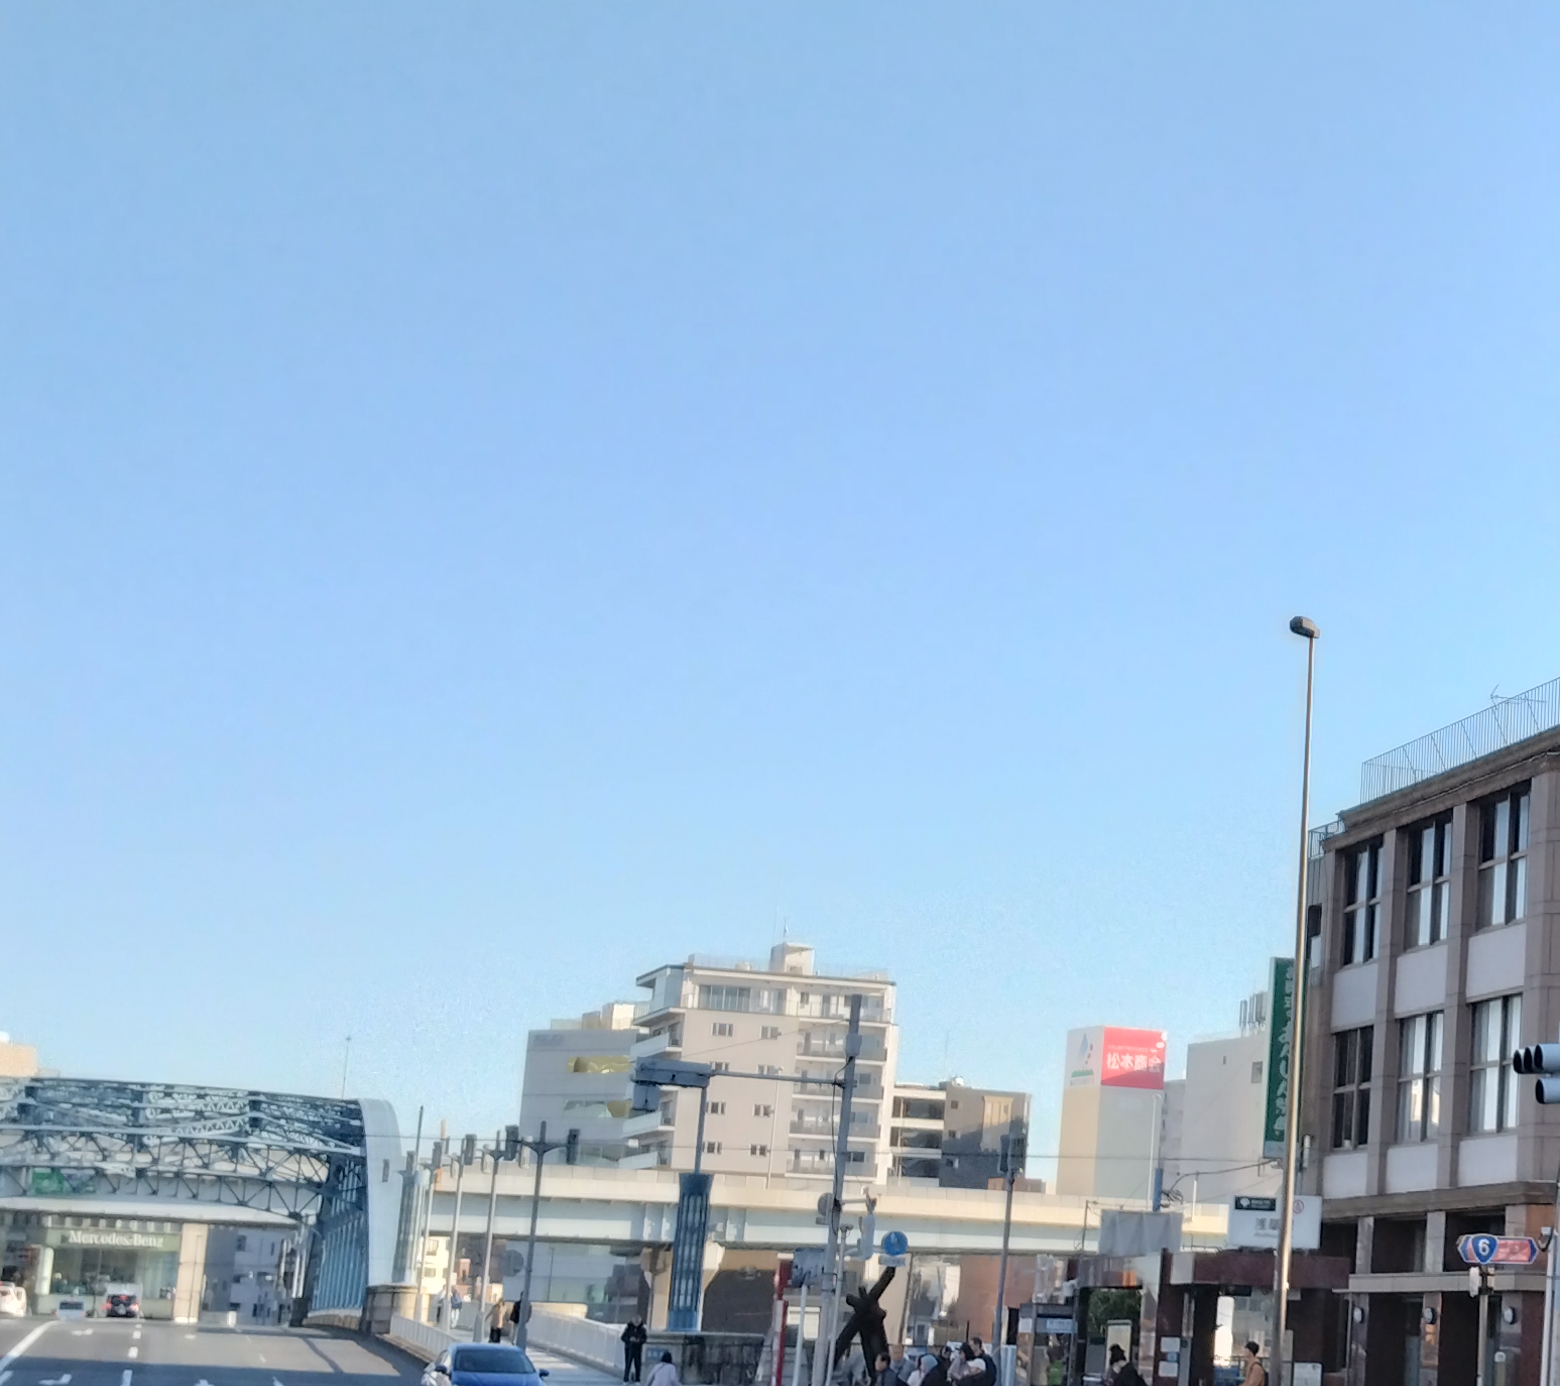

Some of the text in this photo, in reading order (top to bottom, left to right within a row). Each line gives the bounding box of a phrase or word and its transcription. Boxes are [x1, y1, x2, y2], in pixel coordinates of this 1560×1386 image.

[1106, 1051, 1161, 1073] 松本商会
[68, 1229, 164, 1248] Mercedes-Benz
[1478, 1238, 1490, 1256] 6
